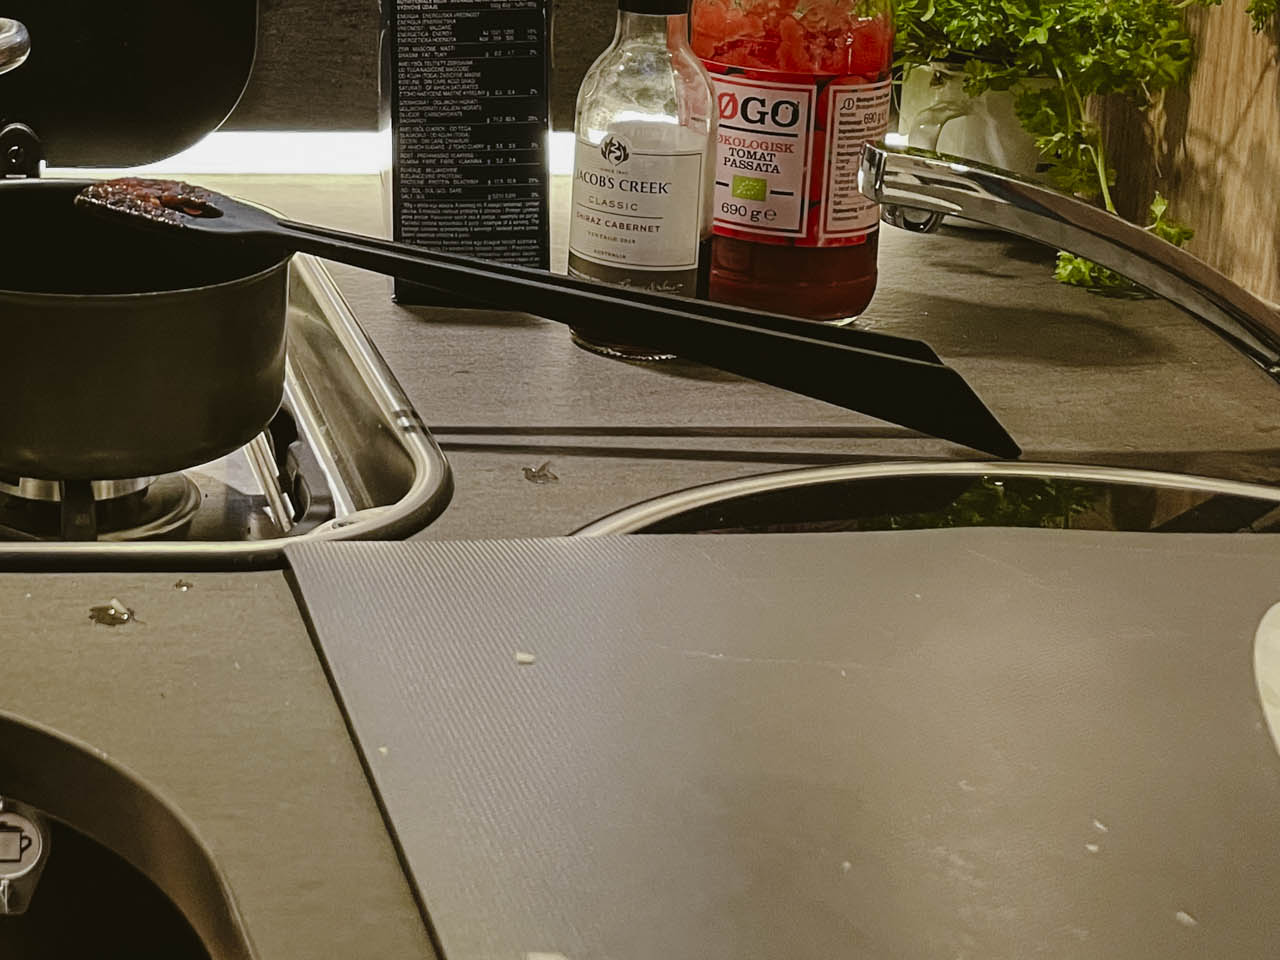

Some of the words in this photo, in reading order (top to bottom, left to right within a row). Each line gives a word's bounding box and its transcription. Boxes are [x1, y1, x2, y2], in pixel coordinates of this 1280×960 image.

[718, 92, 800, 127] ØGO
[728, 147, 776, 162] TOMAT
[723, 156, 781, 174] PASSATA
[619, 179, 669, 194] CREEK
[588, 196, 638, 211] CLASSIC
[721, 202, 748, 216] 690
[605, 220, 660, 232] CABERNET
